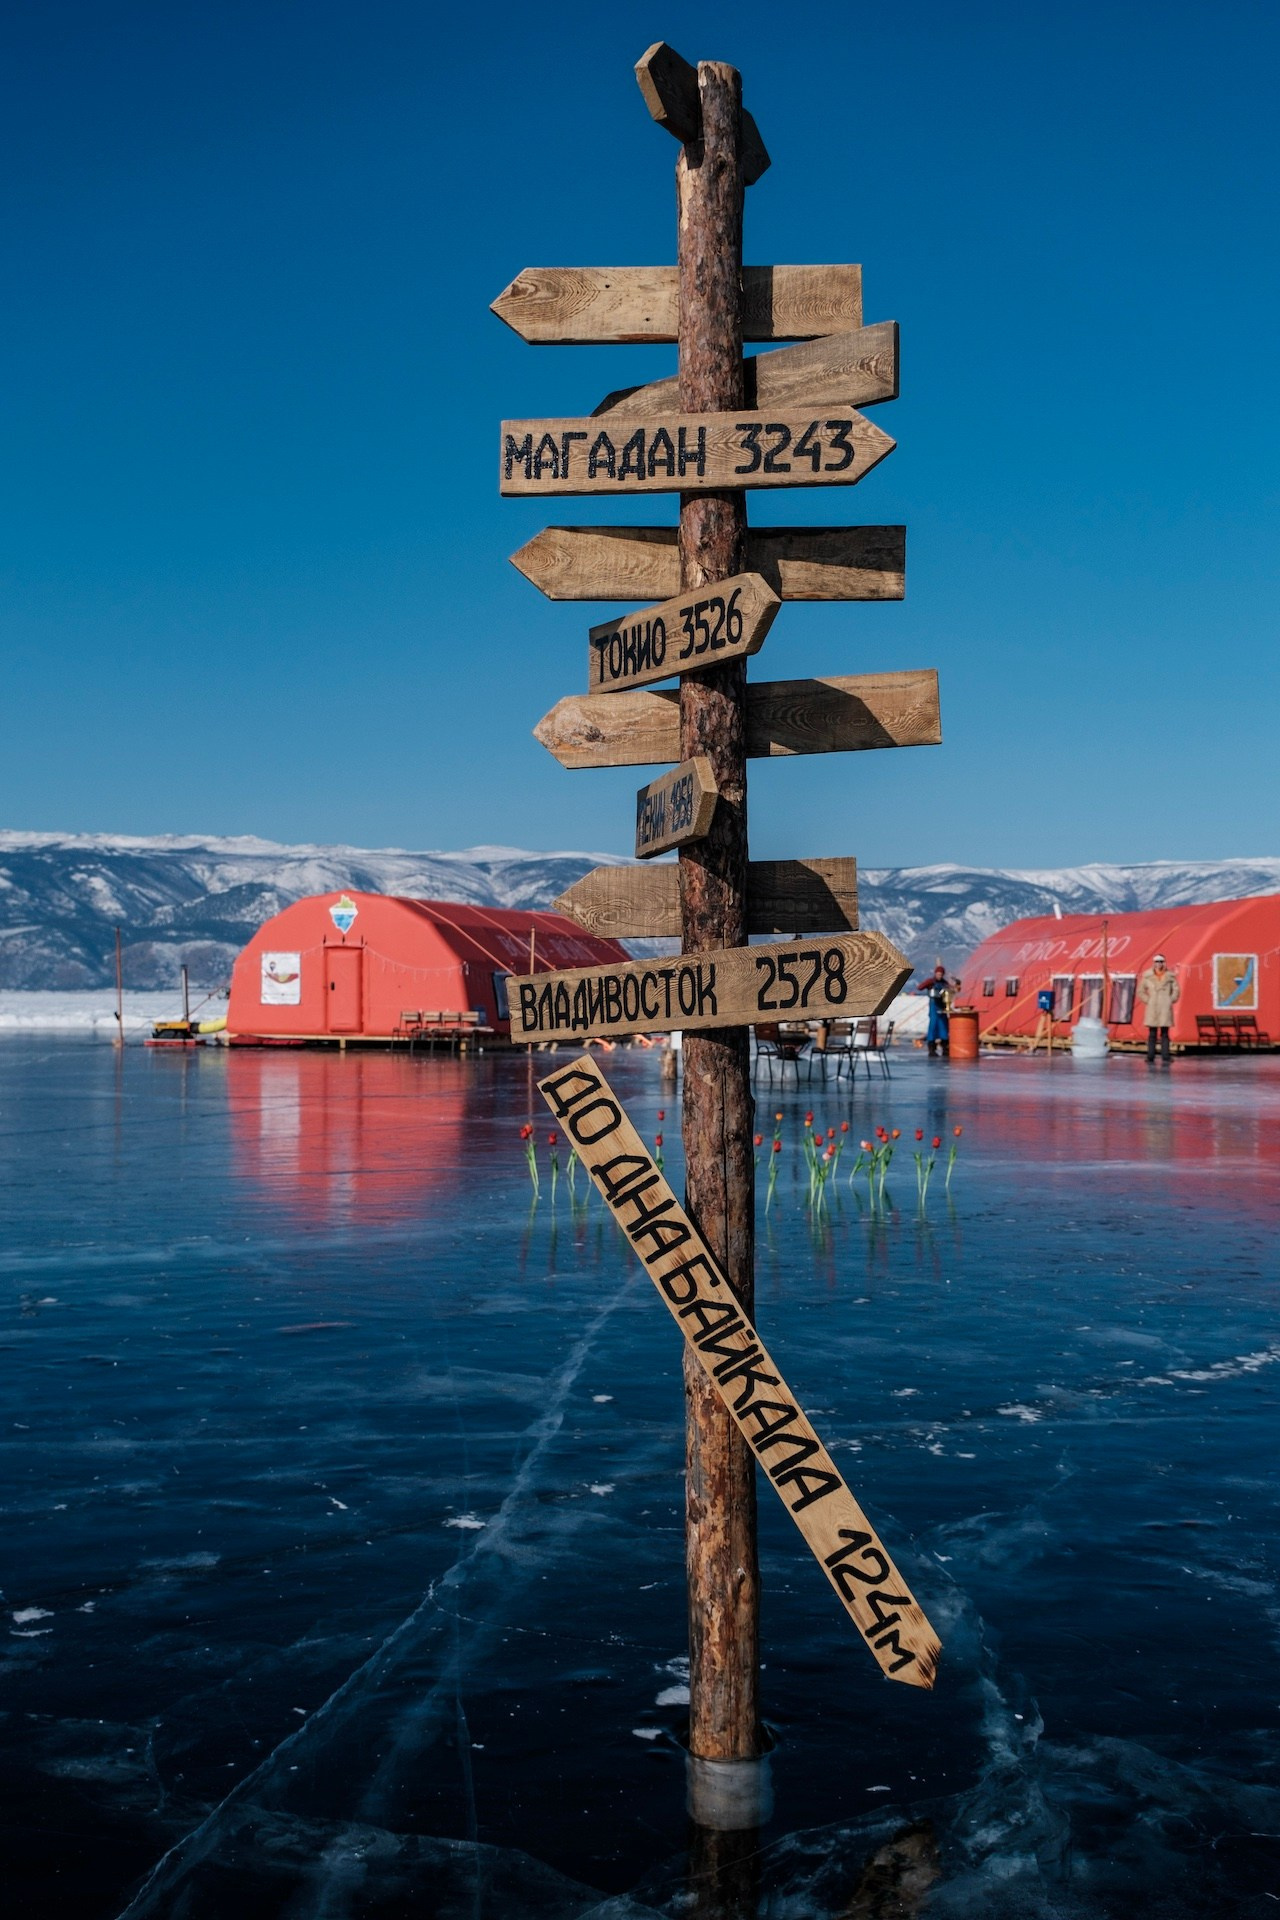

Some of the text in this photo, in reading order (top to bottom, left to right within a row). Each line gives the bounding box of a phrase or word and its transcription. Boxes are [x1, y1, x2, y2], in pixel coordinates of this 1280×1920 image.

[505, 420, 854, 481] МАГАДАН 3243
[595, 587, 743, 683] ТОКИО 3526
[519, 948, 848, 1032] ВЛАДИВОСТОК 2578
[541, 1069, 622, 1146] ДО
[591, 1154, 691, 1264] ДНА
[660, 1253, 842, 1513] БАЙКАЛА
